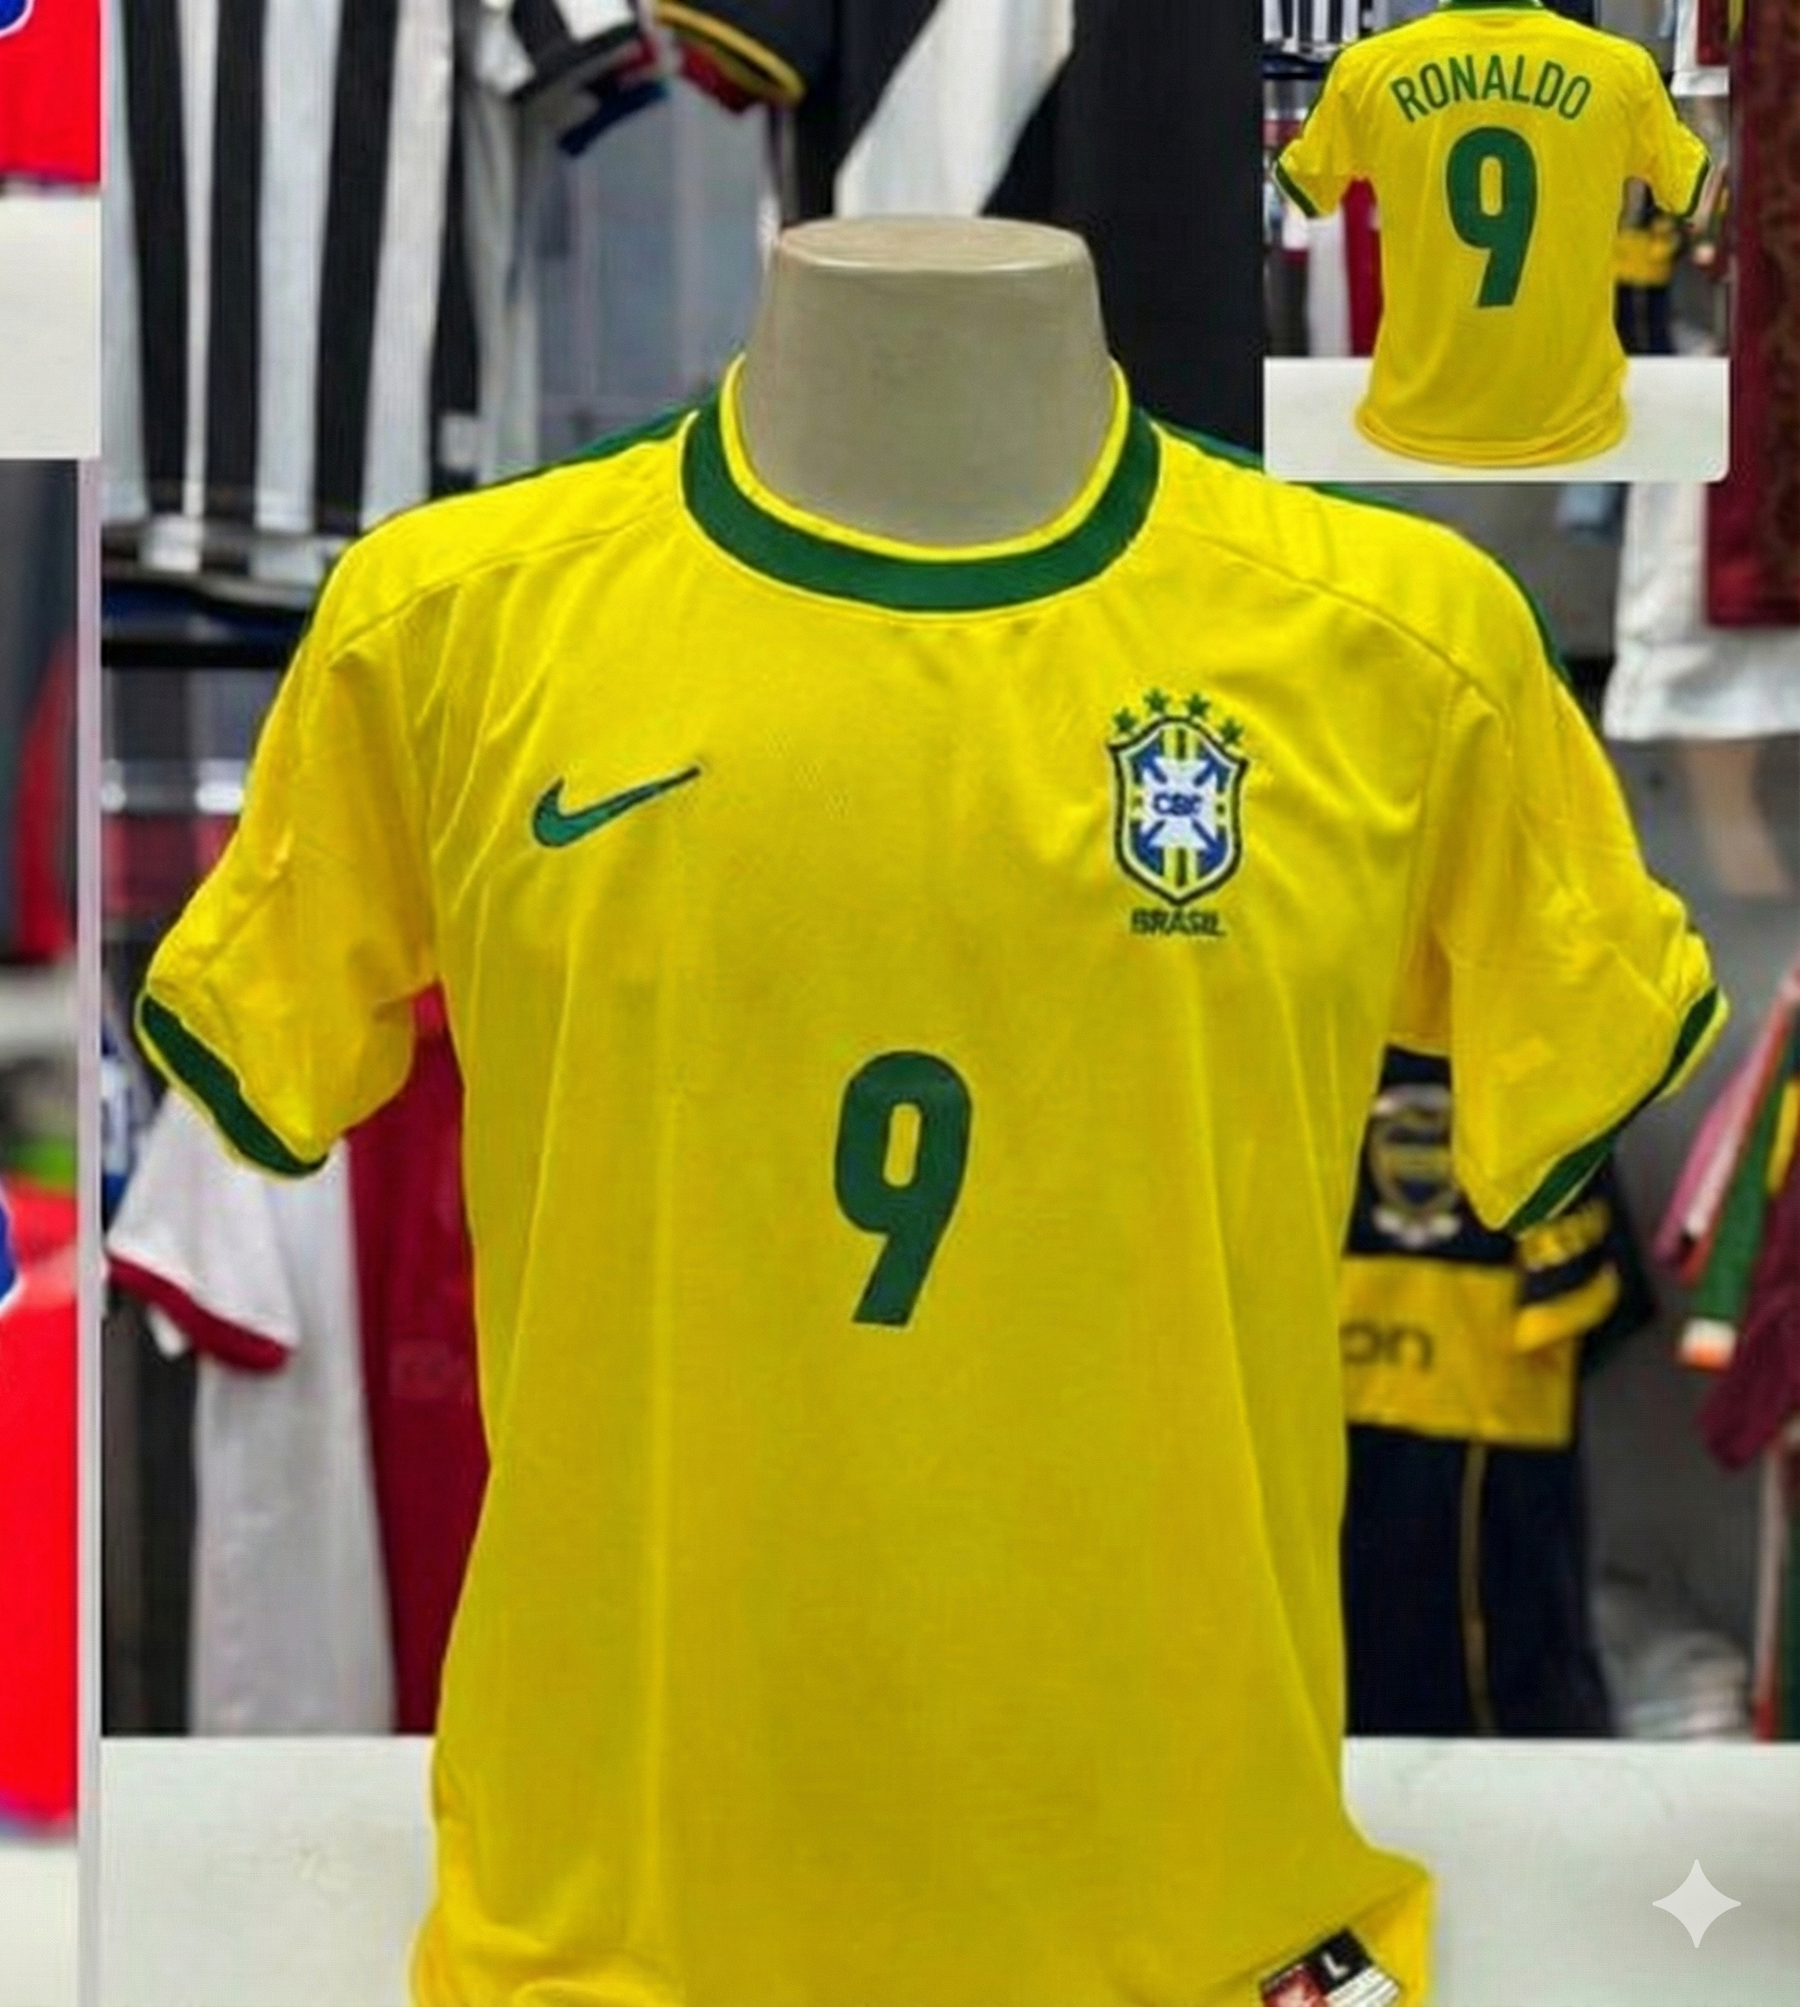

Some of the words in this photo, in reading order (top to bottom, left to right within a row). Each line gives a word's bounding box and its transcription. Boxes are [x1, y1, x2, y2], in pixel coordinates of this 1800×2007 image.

[1391, 54, 1591, 121] RONALDO
[1446, 127, 1537, 308] 9
[1130, 908, 1225, 935] BRASIL
[834, 1051, 972, 1326] 9
[1321, 1951, 1350, 1979] L
